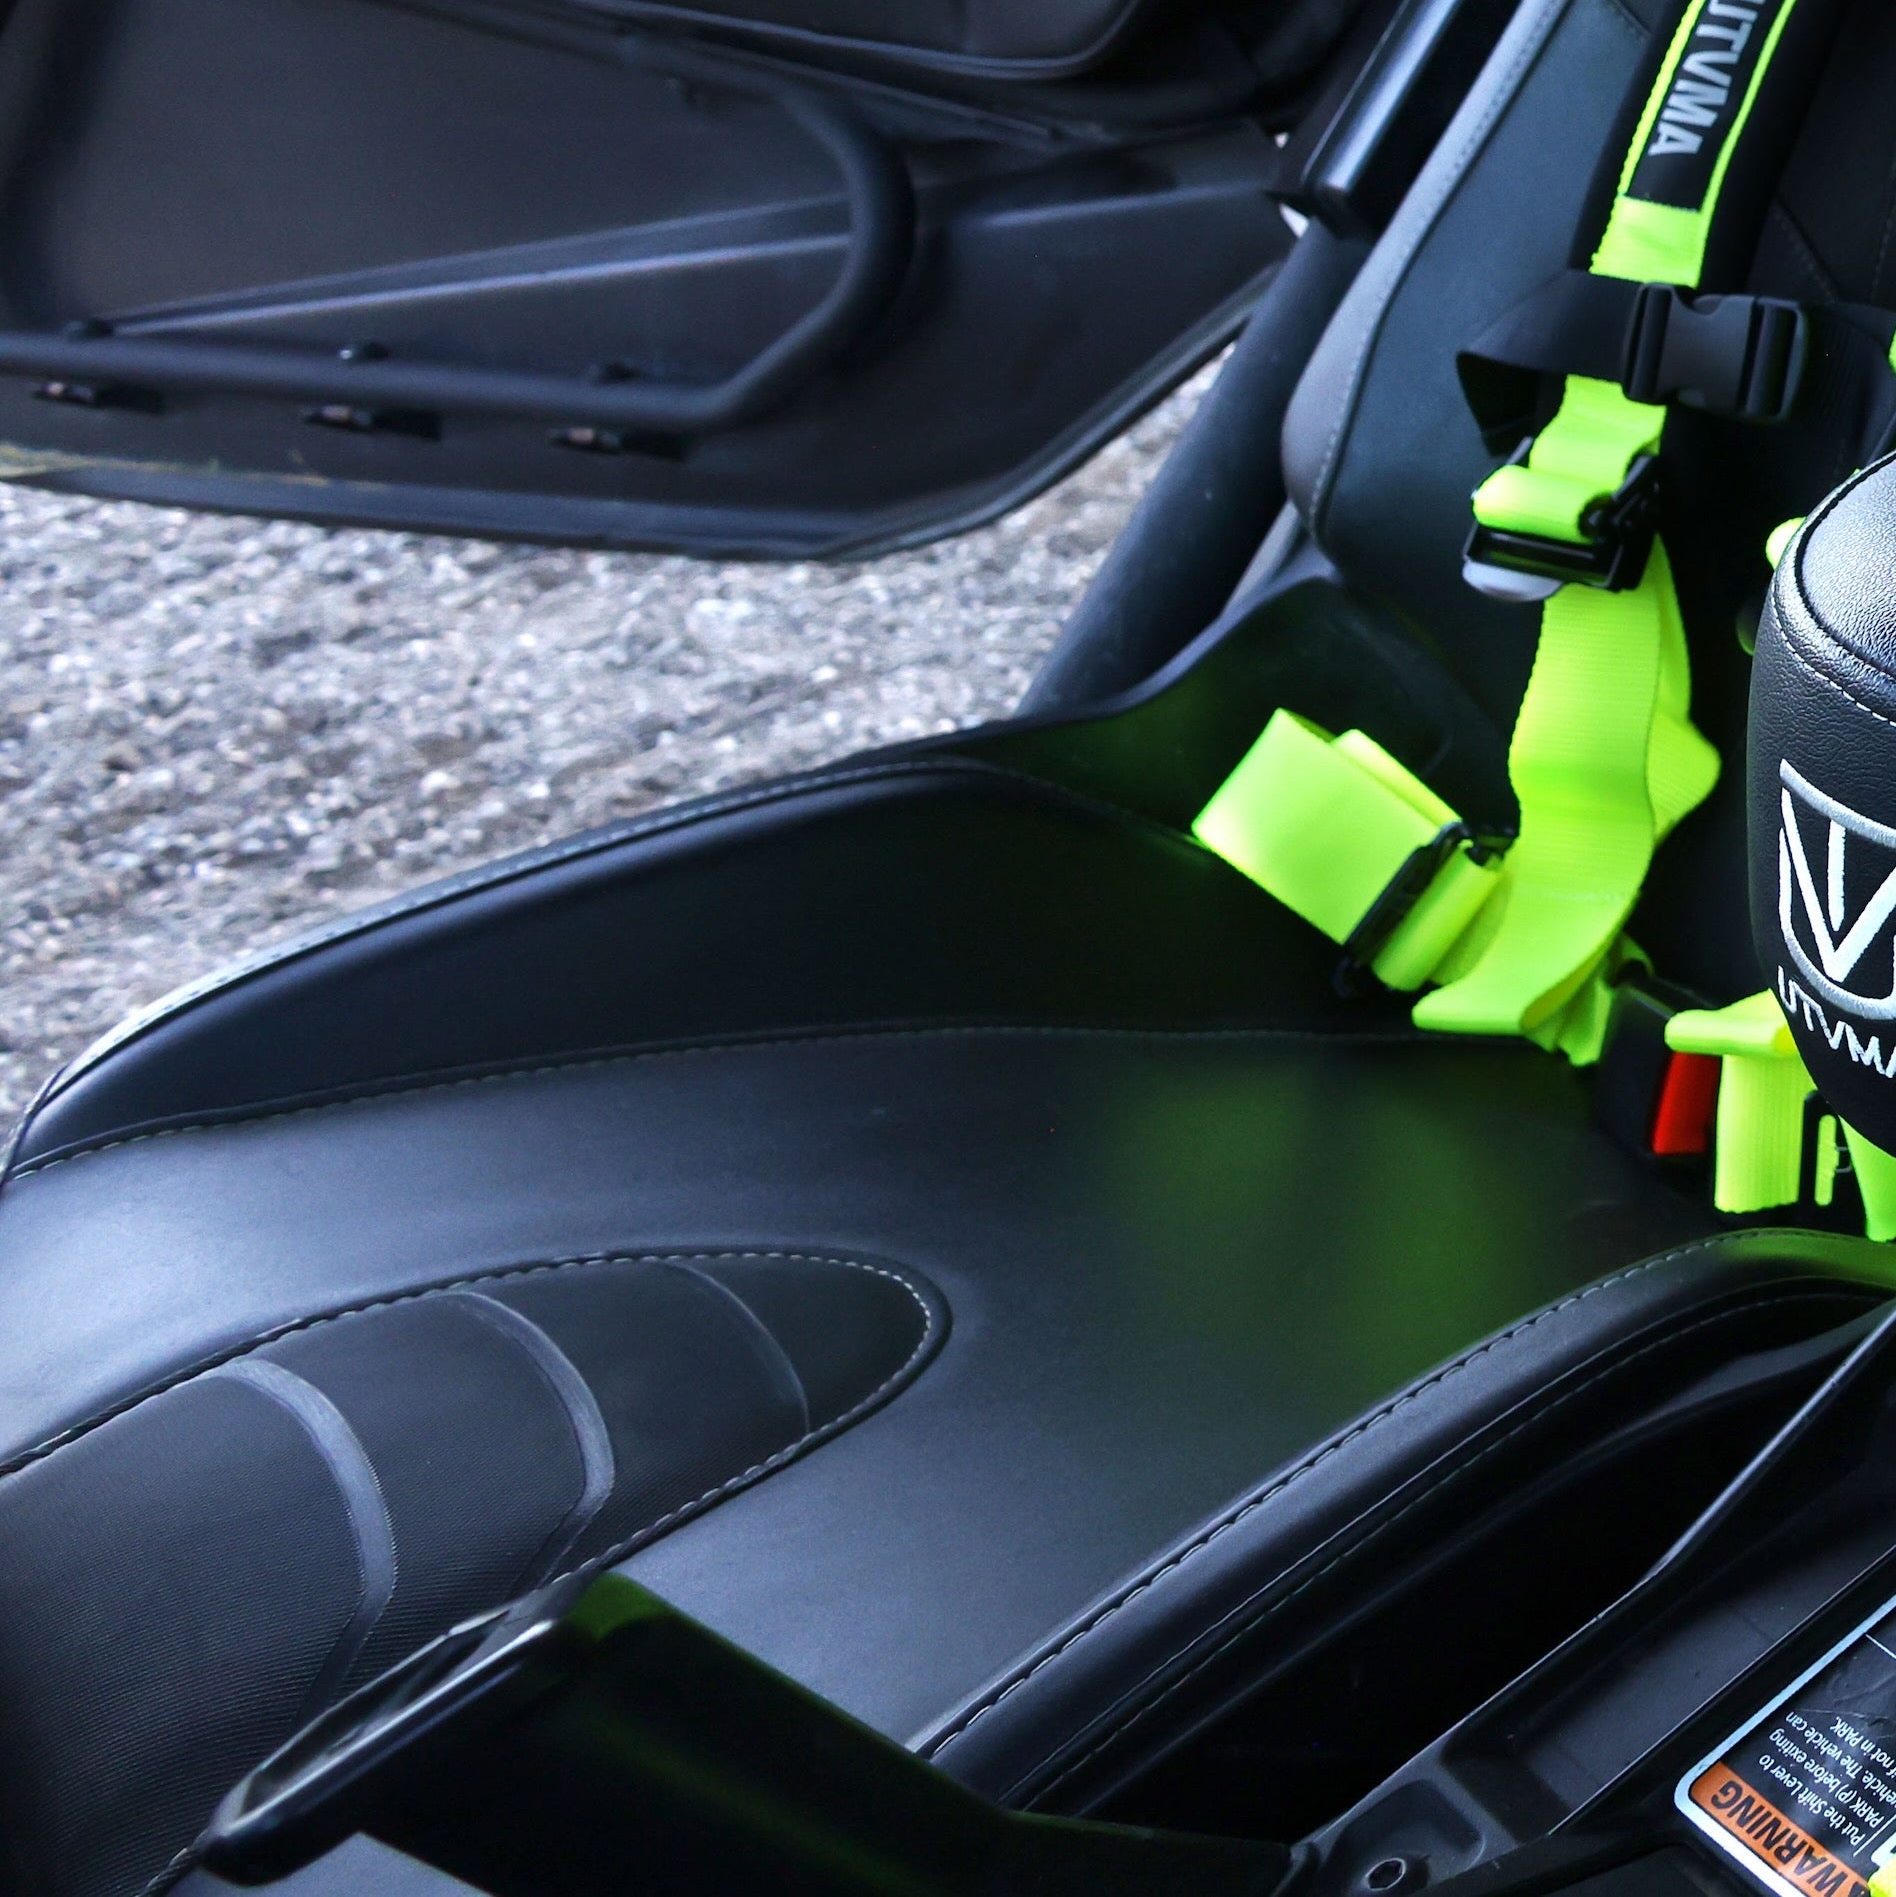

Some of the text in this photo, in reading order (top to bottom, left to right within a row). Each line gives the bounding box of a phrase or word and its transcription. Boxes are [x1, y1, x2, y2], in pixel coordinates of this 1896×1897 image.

[1785, 1711, 1808, 1731] can
[1830, 1716, 1860, 1747] PARK.
[1804, 1729, 1843, 1763] vehicle
[1861, 1738, 1877, 1756] in
[1870, 1750, 1891, 1768] not
[1769, 1728, 1885, 1828] PARK (P) before exiting
[1840, 1758, 1863, 1779] The
[1759, 1754, 1866, 1846] Put the Shift Lever to
[1710, 1779, 1849, 1897] WARNING
